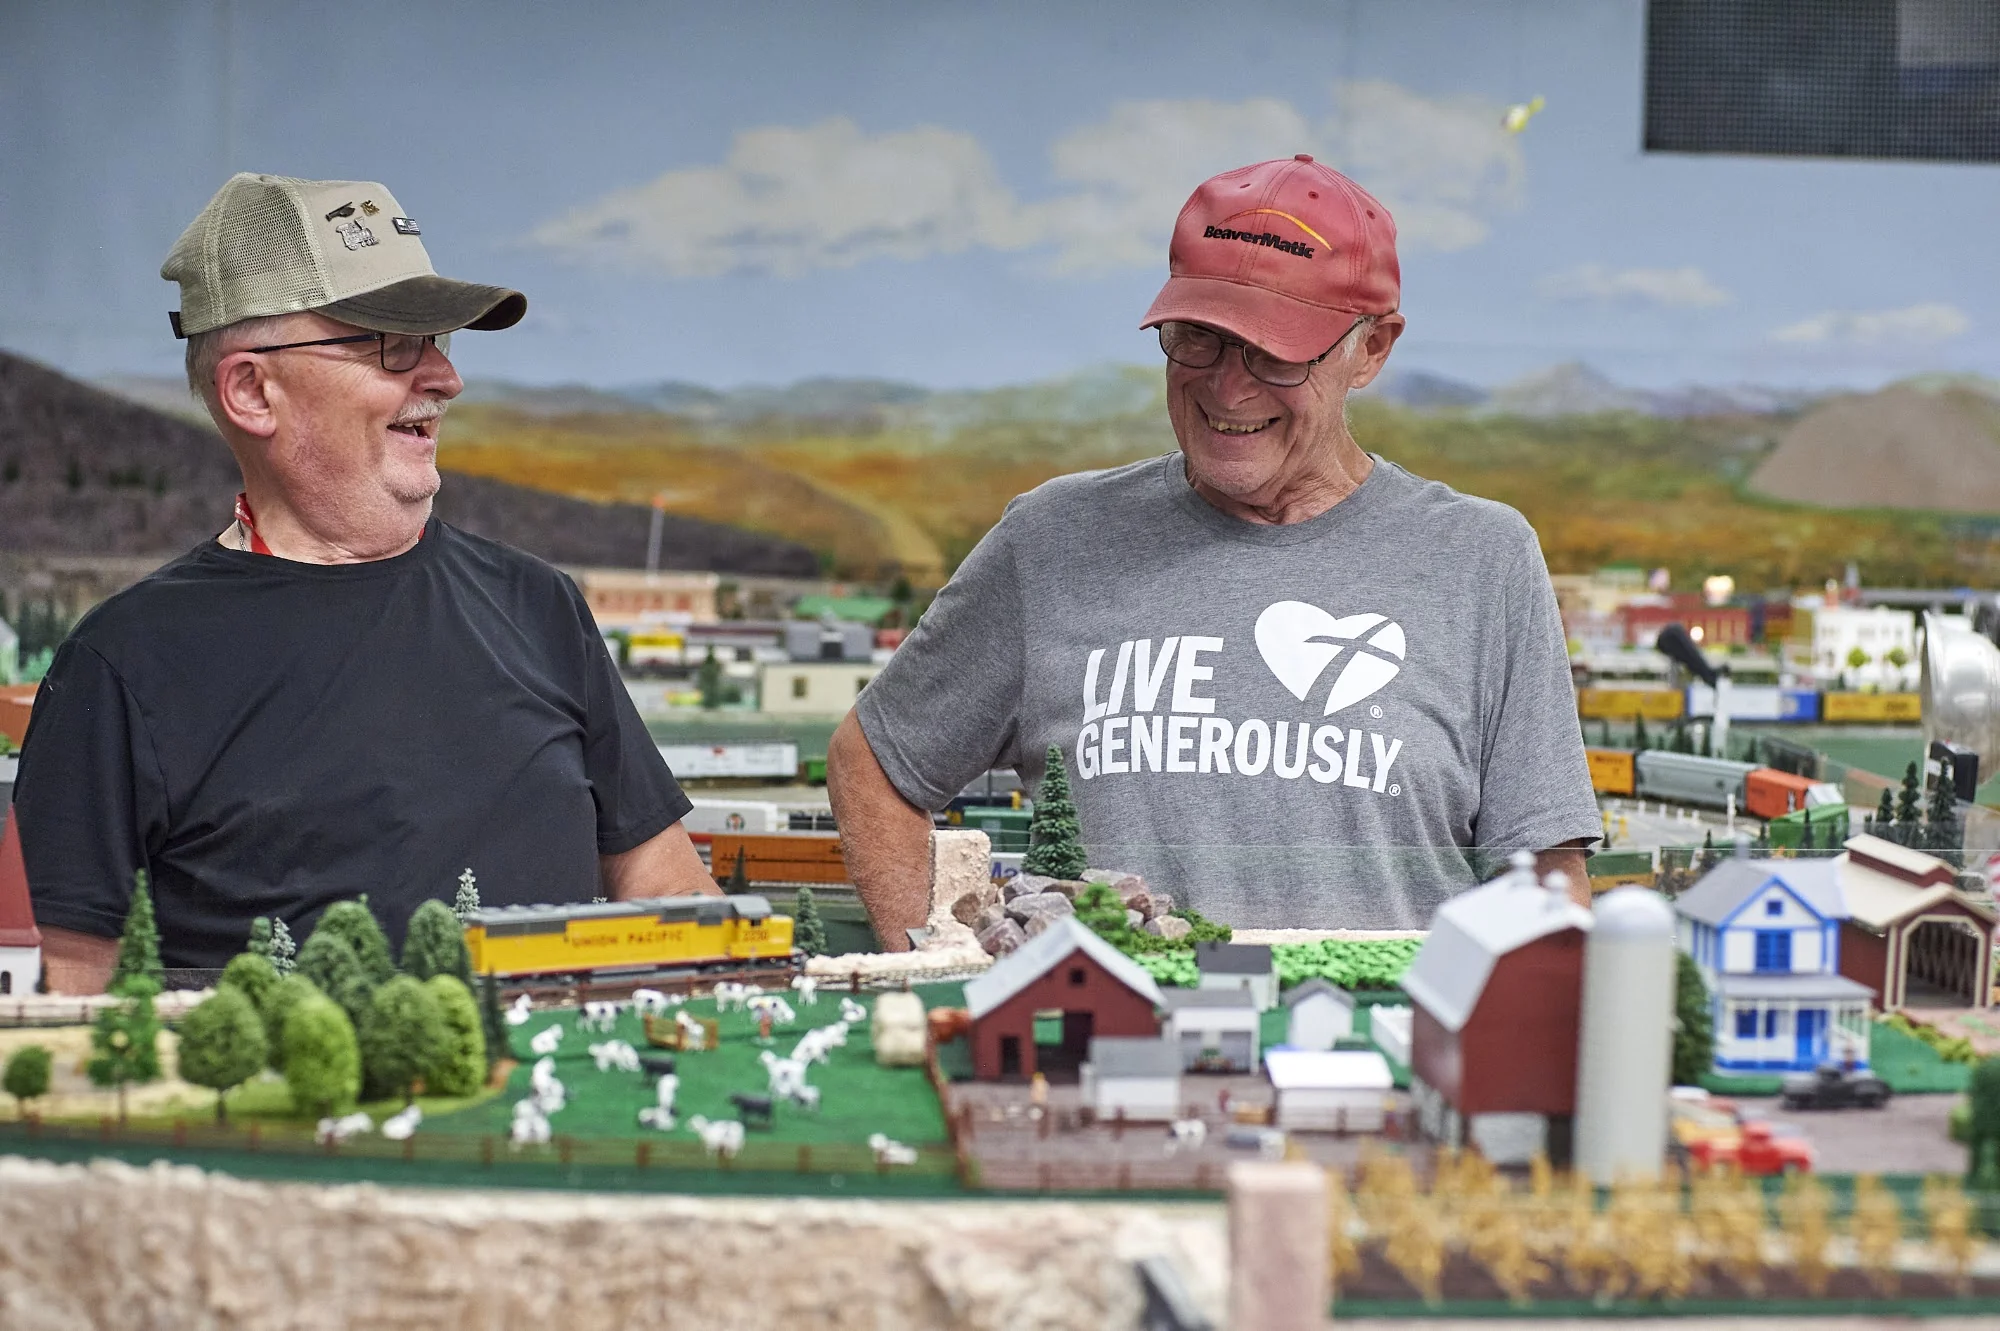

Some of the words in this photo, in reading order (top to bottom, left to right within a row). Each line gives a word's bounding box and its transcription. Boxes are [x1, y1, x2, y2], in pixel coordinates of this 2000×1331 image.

[1203, 225, 1315, 259] BeaverMatic
[1082, 636, 1225, 724] LIVE
[571, 936, 618, 949] UNION
[627, 929, 682, 944] PACIFIC
